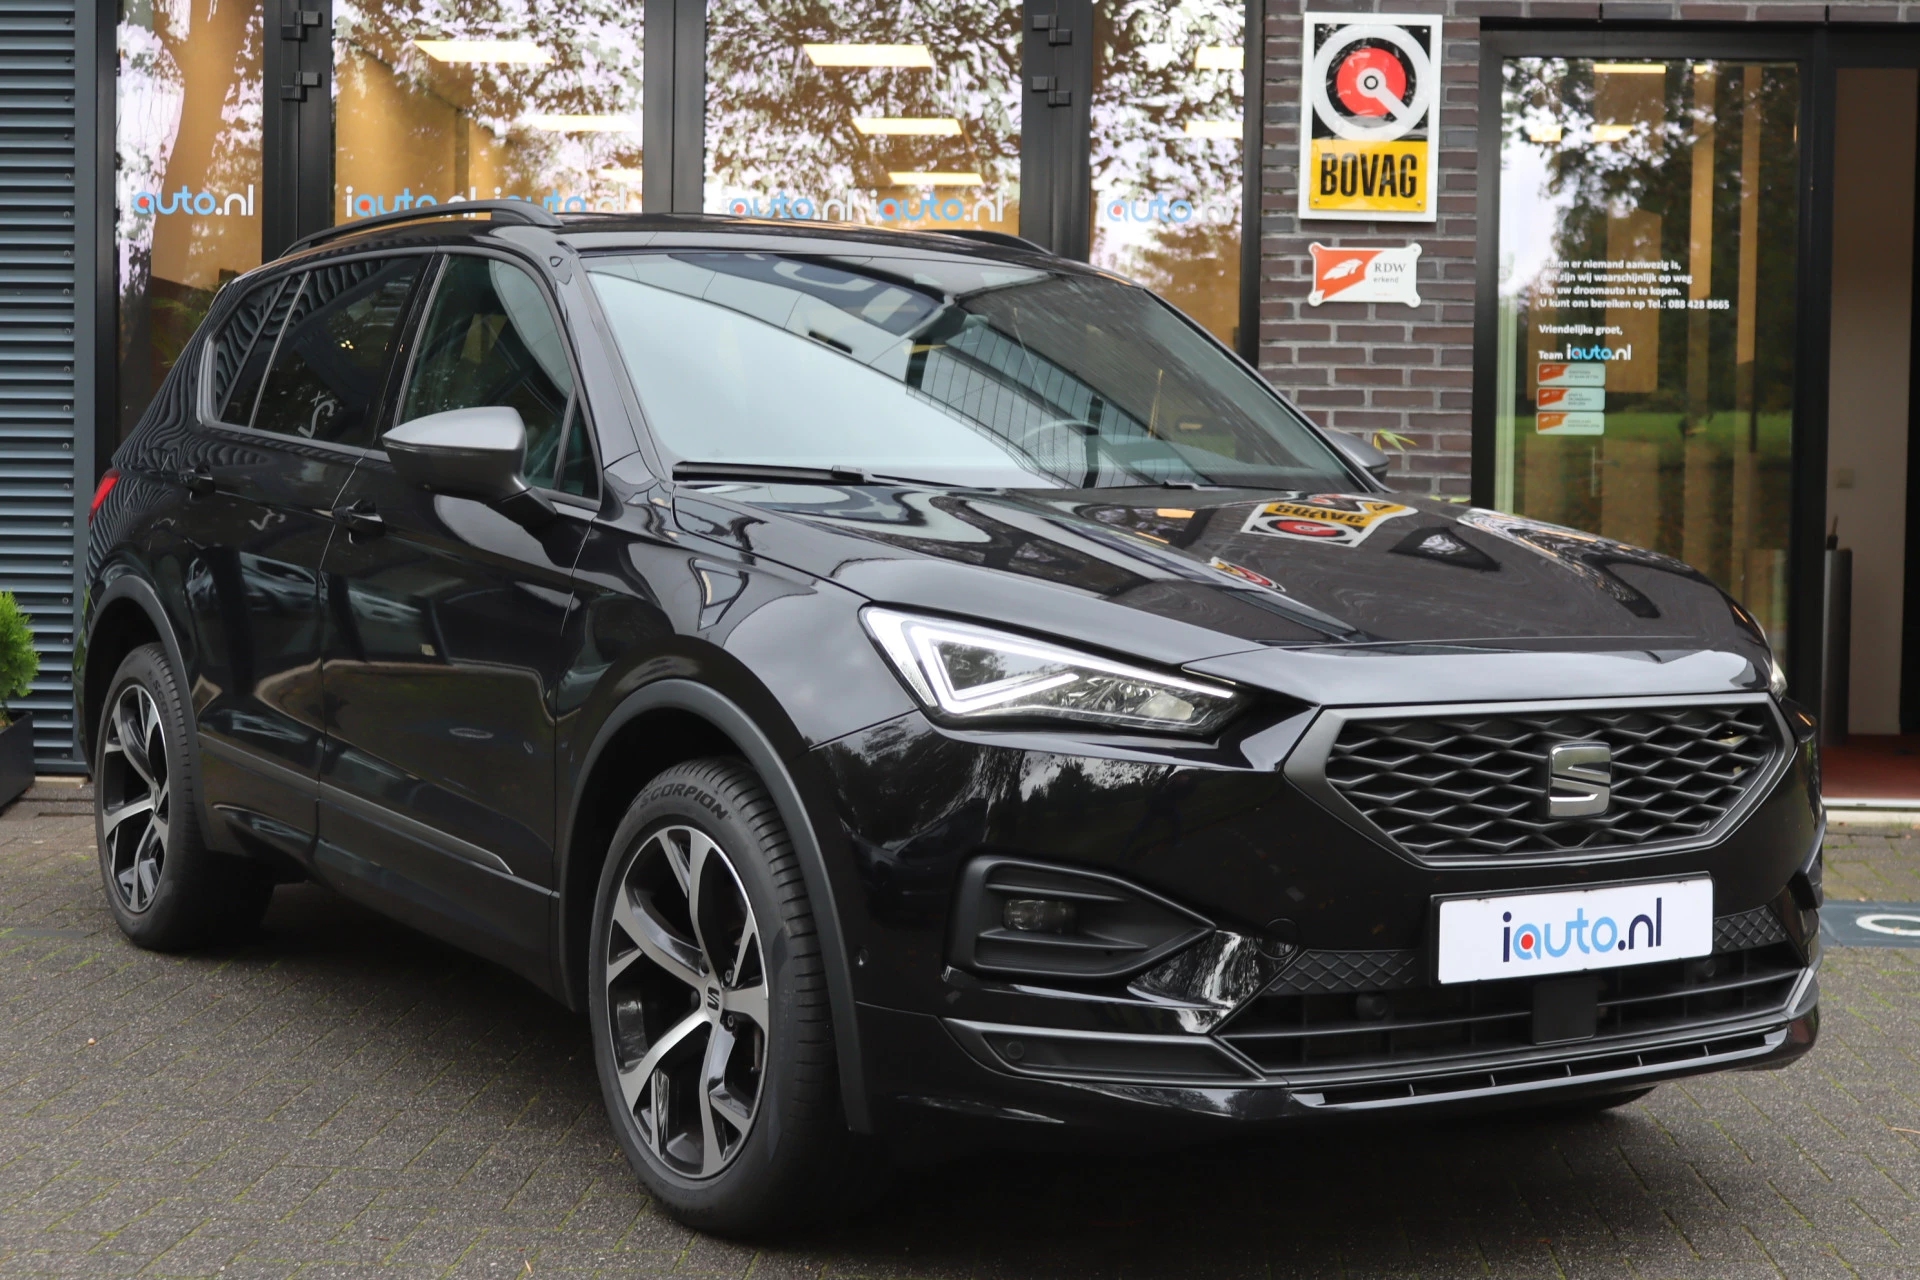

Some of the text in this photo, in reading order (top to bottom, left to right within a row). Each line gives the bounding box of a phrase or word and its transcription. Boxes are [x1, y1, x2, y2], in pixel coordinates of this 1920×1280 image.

[1320, 153, 1417, 198] BOVAG
[125, 184, 254, 216] auto.nl
[346, 185, 477, 218] iautonl
[870, 189, 1004, 222] iauto.nl
[1374, 262, 1407, 273] RDW
[1542, 260, 1682, 271] ndien er niemand aanwezig is,
[1373, 276, 1399, 284] erkend
[1560, 272, 1576, 283] zijn
[1579, 272, 1592, 283] wij
[1594, 272, 1657, 284] waarschijnlijk
[1658, 274, 1671, 284] op
[1673, 274, 1693, 285] weg
[1540, 285, 1682, 297] om uw droomauto in te kopen.
[1540, 299, 1730, 310] U kunt ons bereiken op Tel.: 088 428 8665
[1538, 324, 1623, 336] Vriendelijke groet,
[1538, 343, 1631, 361] Team iauto.nl
[640, 783, 729, 820] SCORPION
[1503, 898, 1663, 962] iauto.nl
